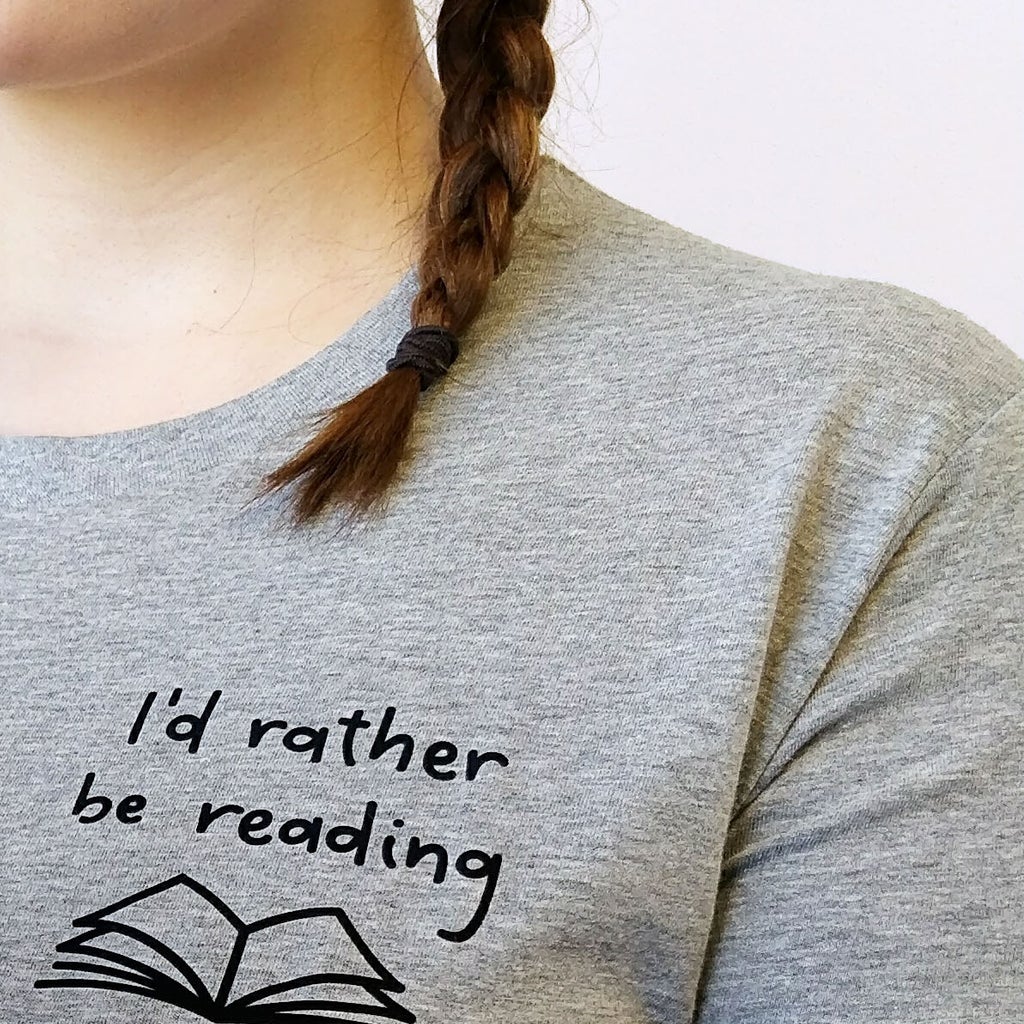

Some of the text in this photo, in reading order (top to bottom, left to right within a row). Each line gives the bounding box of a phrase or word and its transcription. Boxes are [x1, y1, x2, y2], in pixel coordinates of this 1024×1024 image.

[128, 688, 509, 781] I'd rather
[72, 773, 503, 943] be reading
